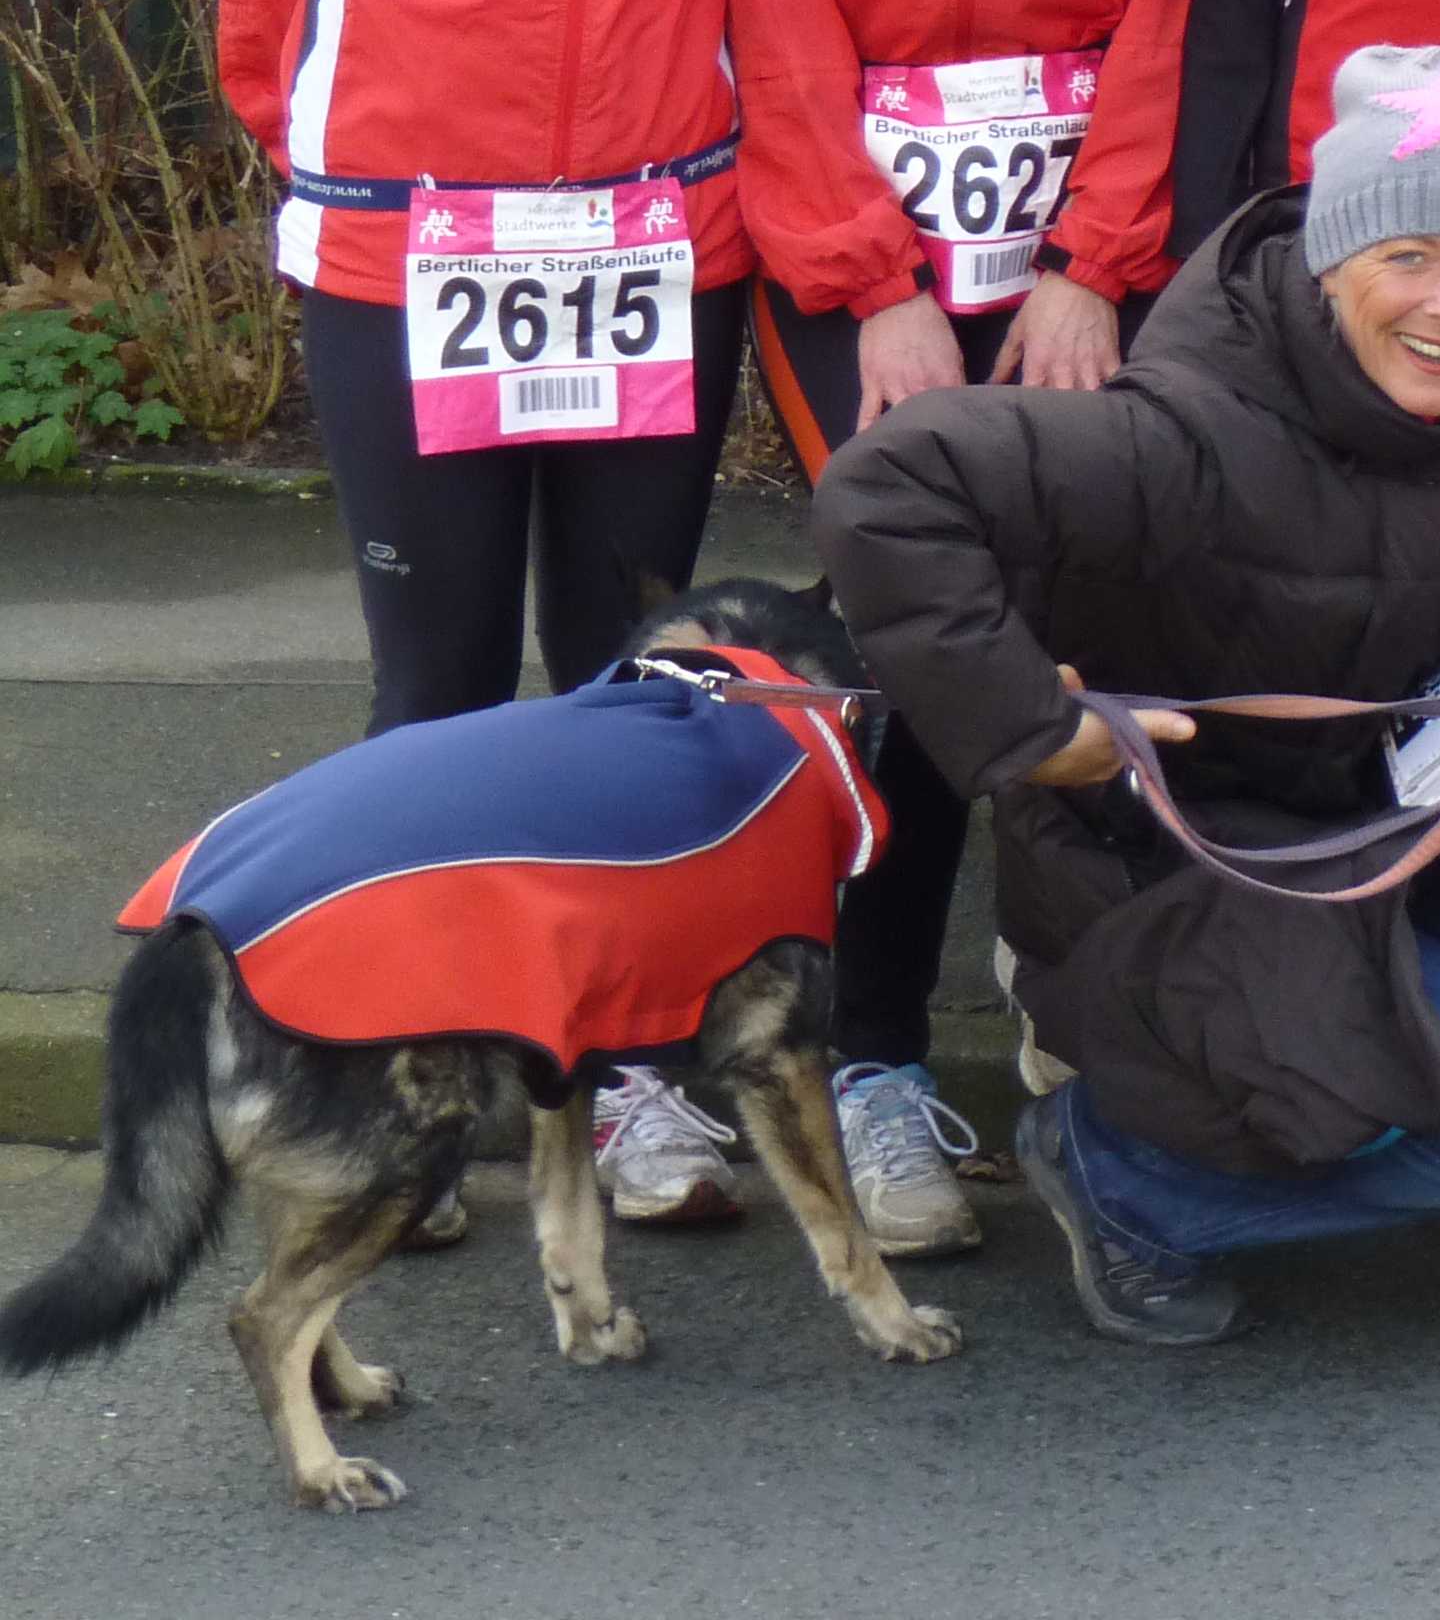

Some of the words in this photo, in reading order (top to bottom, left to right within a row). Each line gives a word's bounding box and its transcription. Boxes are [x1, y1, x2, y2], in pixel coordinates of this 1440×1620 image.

[943, 86, 1019, 104] Stadtwerke
[892, 137, 1084, 235] 2627
[495, 217, 577, 233] Stadtwerke
[416, 258, 533, 273] Bertlicher
[541, 246, 687, 273] Straßenläufe
[436, 268, 661, 370] 2615
